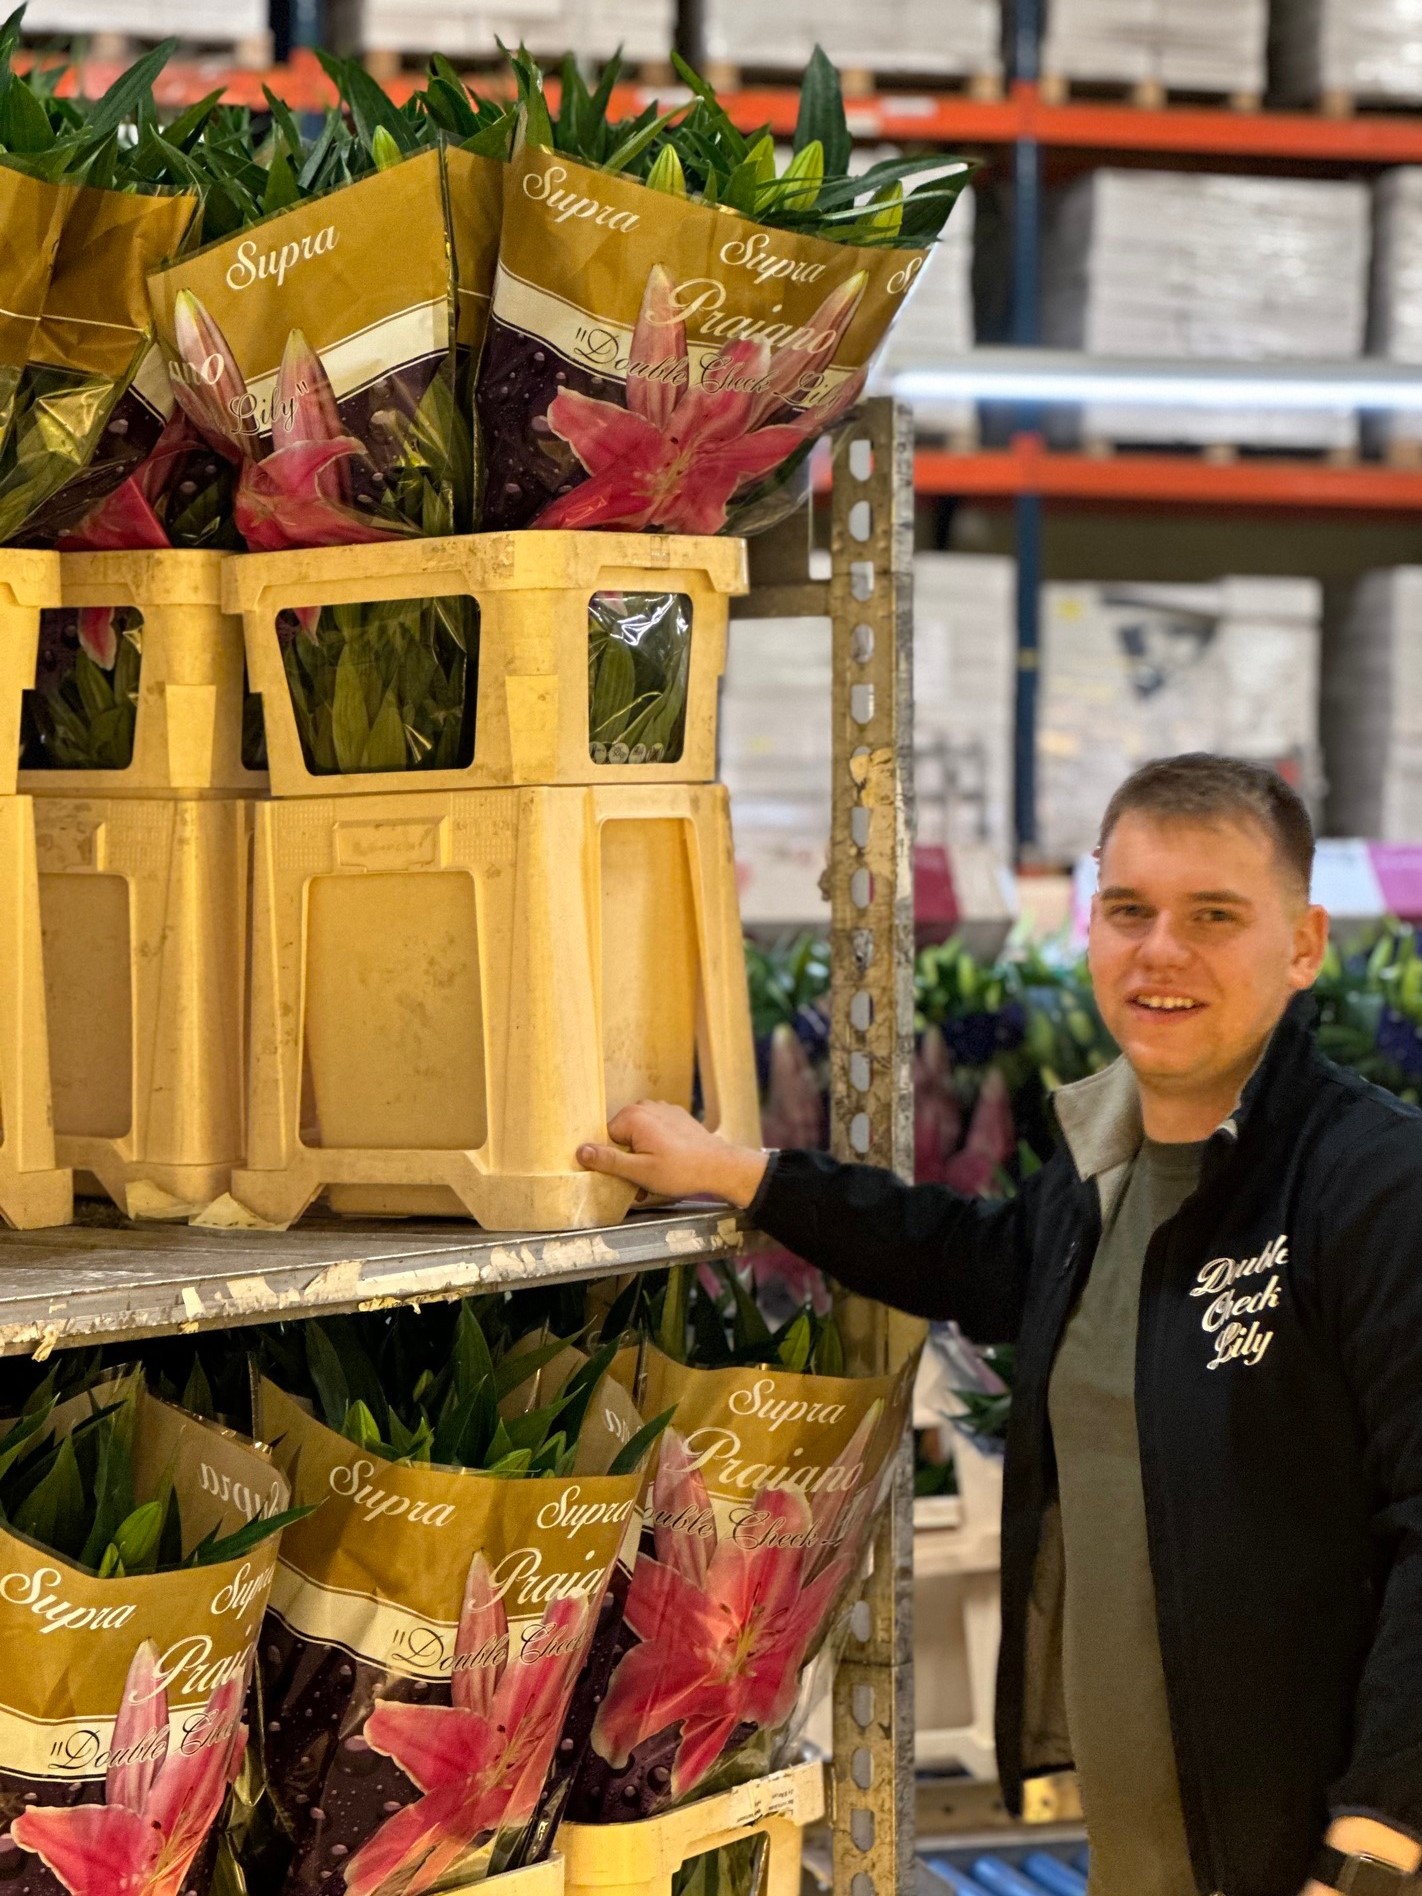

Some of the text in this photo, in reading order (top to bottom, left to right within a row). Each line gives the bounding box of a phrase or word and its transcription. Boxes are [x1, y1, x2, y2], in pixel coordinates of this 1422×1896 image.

[523, 166, 640, 232] Supra
[226, 225, 340, 290] Supra
[720, 234, 826, 284] Supra
[887, 257, 922, 294] S
[645, 278, 836, 354] Praiano
[700, 352, 781, 395] Check
[1202, 1275, 1282, 1332] Check
[1206, 1321, 1274, 1370] Lily
[728, 1378, 847, 1432] Supra
[664, 1426, 864, 1493] Praiano
[330, 1459, 457, 1527] Supra
[536, 1485, 633, 1539] Supra
[643, 1503, 715, 1539] ouble
[728, 1507, 825, 1550] Check
[0, 1567, 137, 1633] Supra
